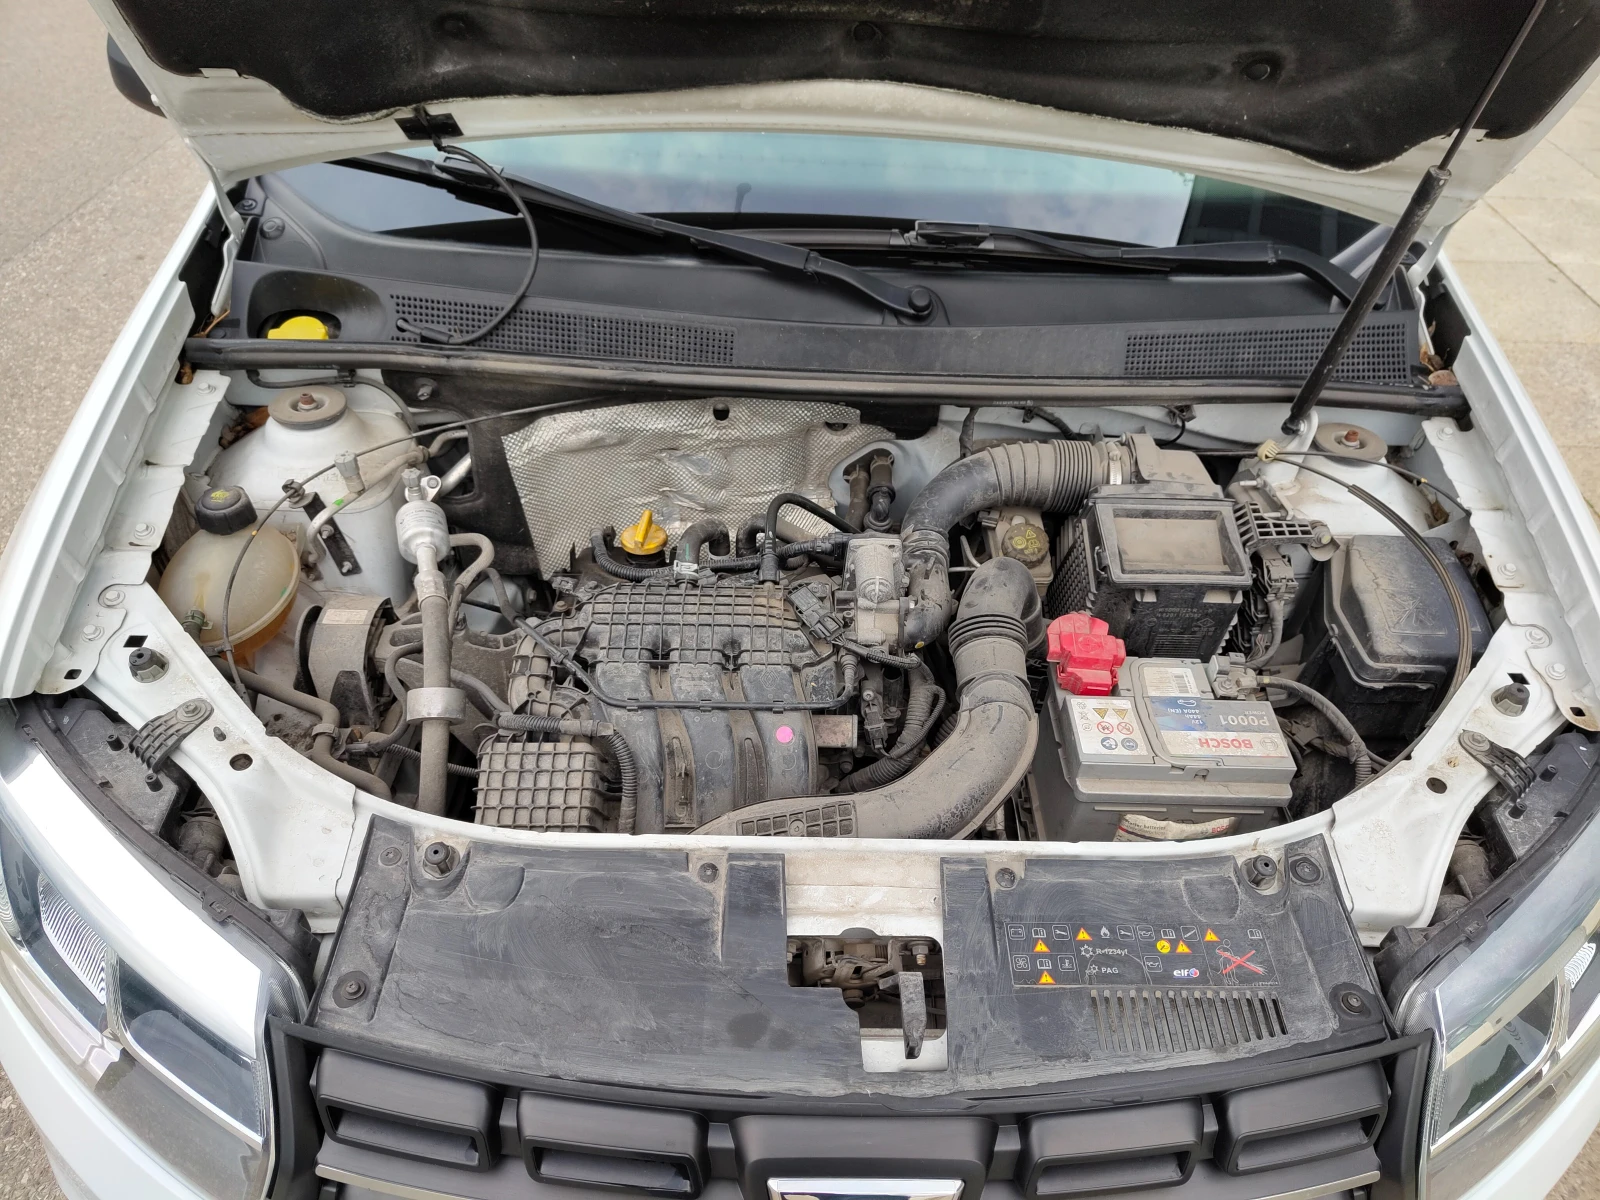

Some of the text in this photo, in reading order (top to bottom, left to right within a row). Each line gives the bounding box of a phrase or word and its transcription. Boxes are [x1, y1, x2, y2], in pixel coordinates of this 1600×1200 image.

[1219, 714, 1270, 726] P0001
[1198, 738, 1254, 749] BOSCH
[1101, 966, 1119, 974] PAG
[1173, 969, 1190, 977] elf
